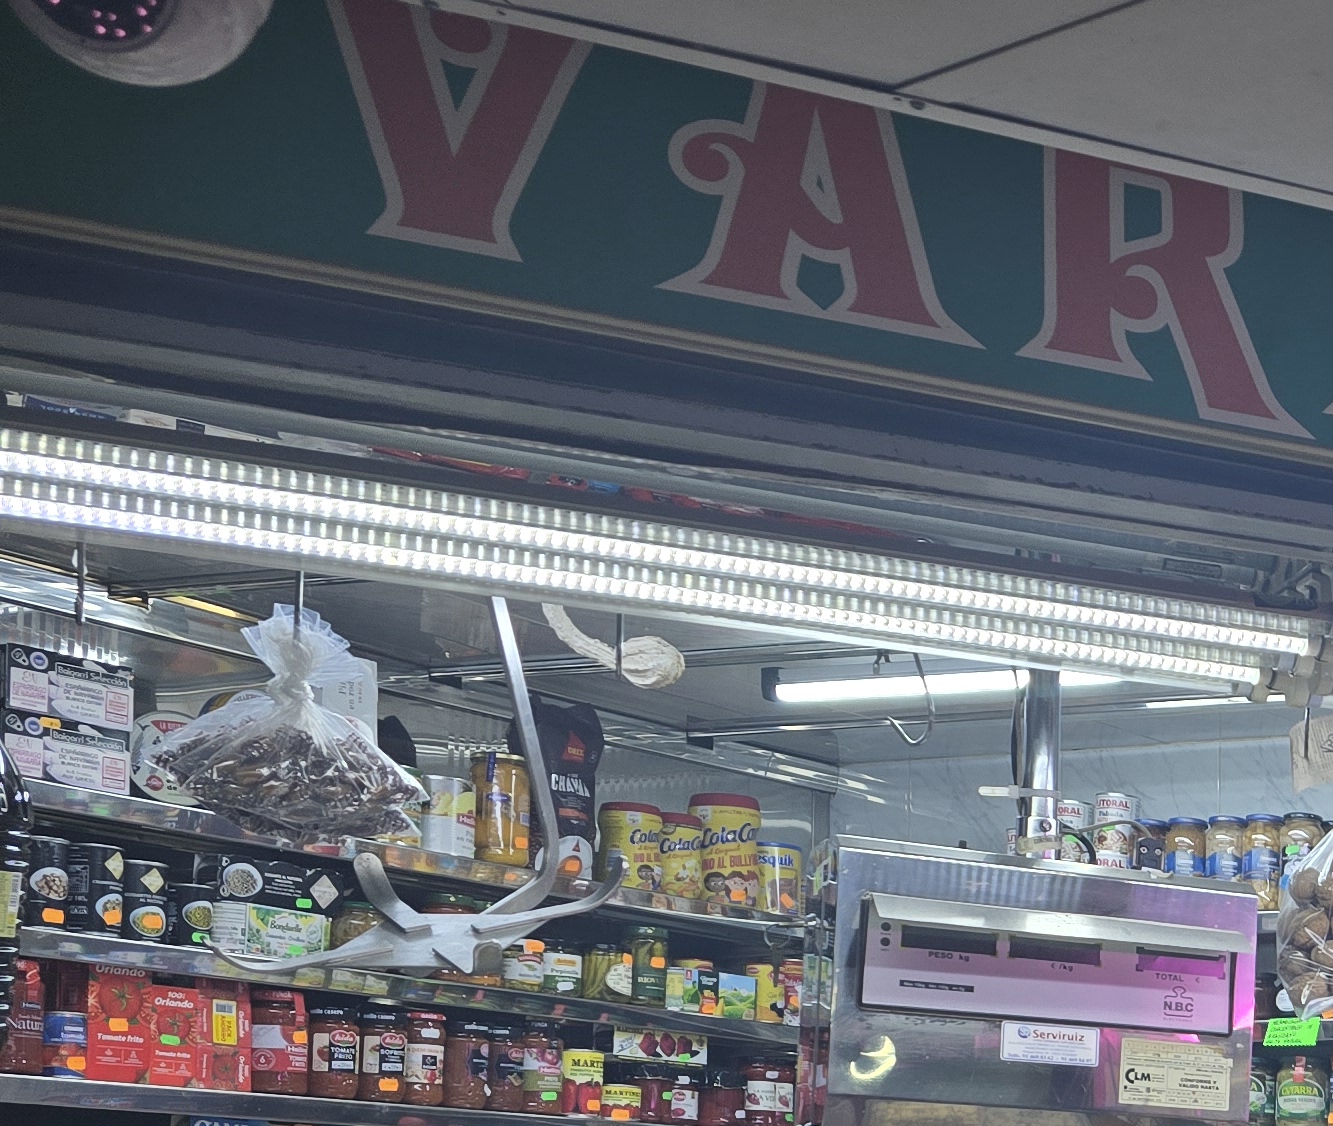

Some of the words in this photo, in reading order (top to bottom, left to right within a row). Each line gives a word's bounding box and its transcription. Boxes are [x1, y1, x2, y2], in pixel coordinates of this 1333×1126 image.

[928, 951, 954, 960] PESO
[958, 953, 971, 963] kg
[95, 964, 146, 977] Orlando
[1154, 971, 1185, 982] TOTAL
[154, 997, 194, 1009] Orlando
[97, 1032, 124, 1042] Tomate
[126, 1034, 144, 1044] frito
[1032, 1028, 1086, 1043] Serviruiz
[1125, 1067, 1152, 1084] CLM
